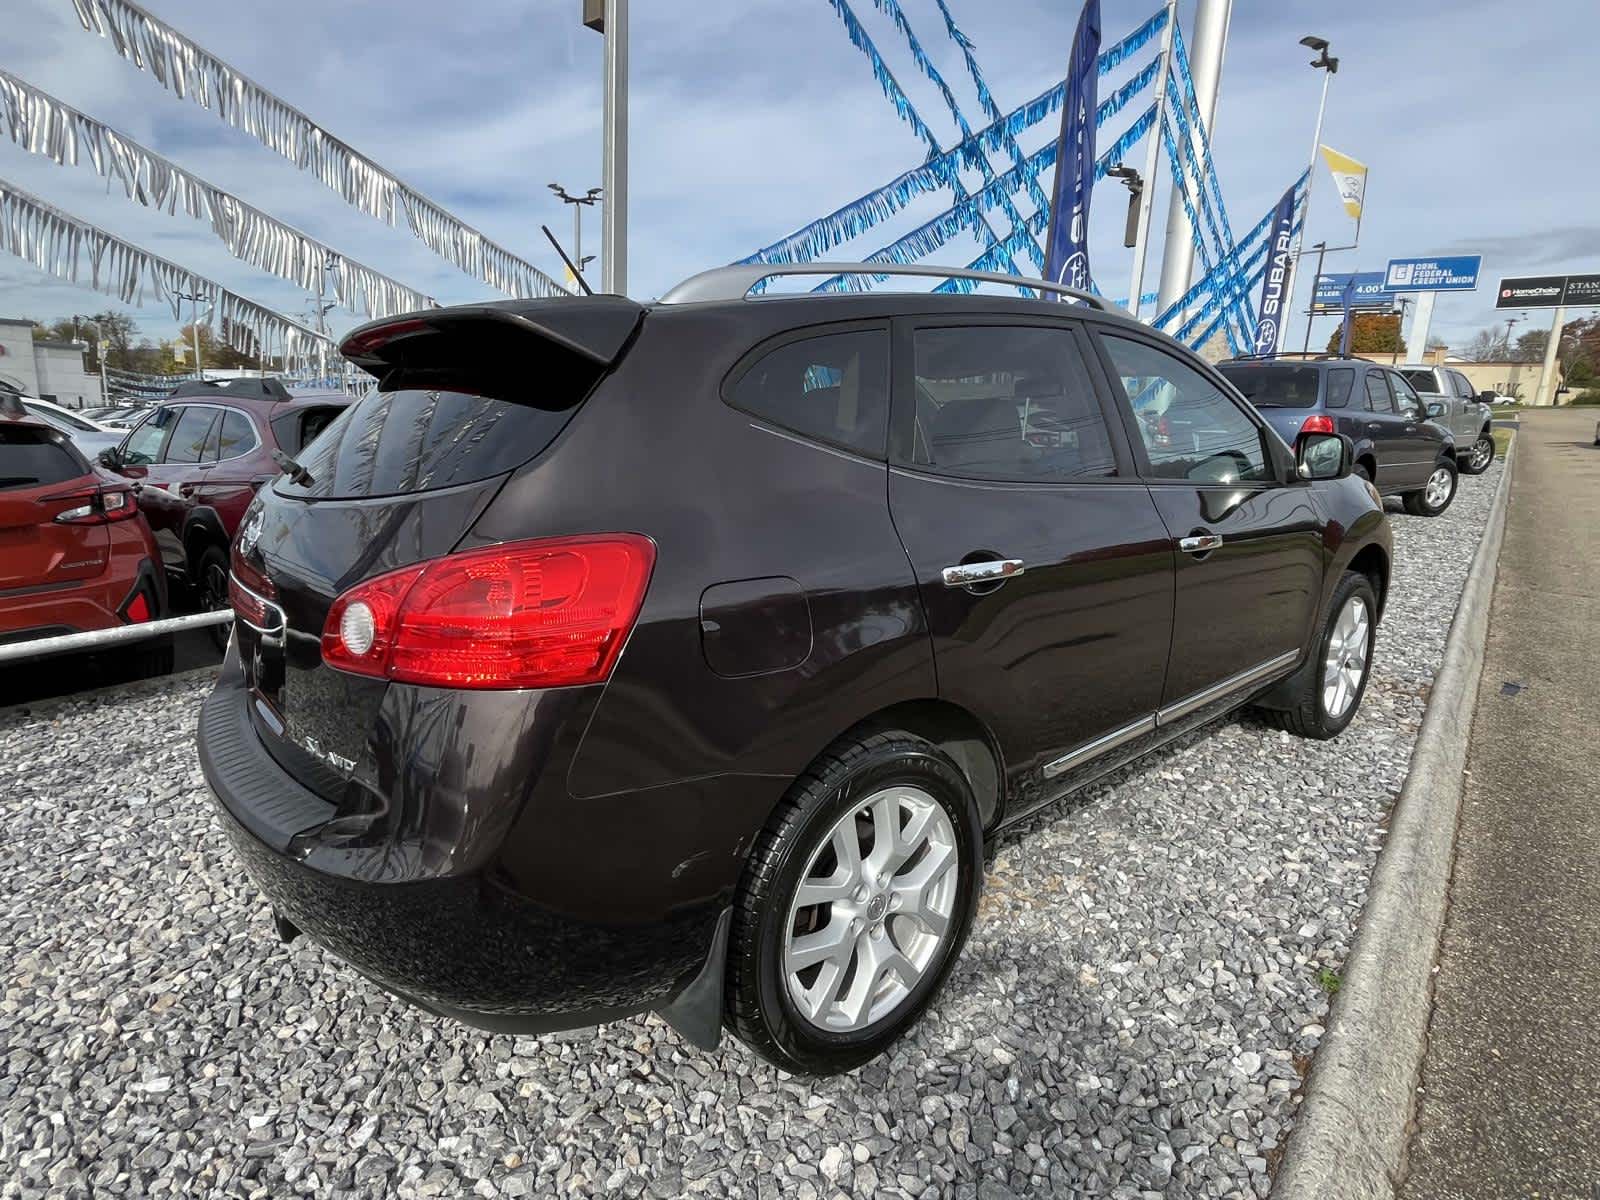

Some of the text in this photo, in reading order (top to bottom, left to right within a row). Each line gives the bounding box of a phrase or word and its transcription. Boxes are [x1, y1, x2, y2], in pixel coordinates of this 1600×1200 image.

[1414, 269, 1453, 277] FEDERAL
[1412, 276, 1475, 285] CREDIT UNION
[1512, 287, 1561, 296] HomeChoice
